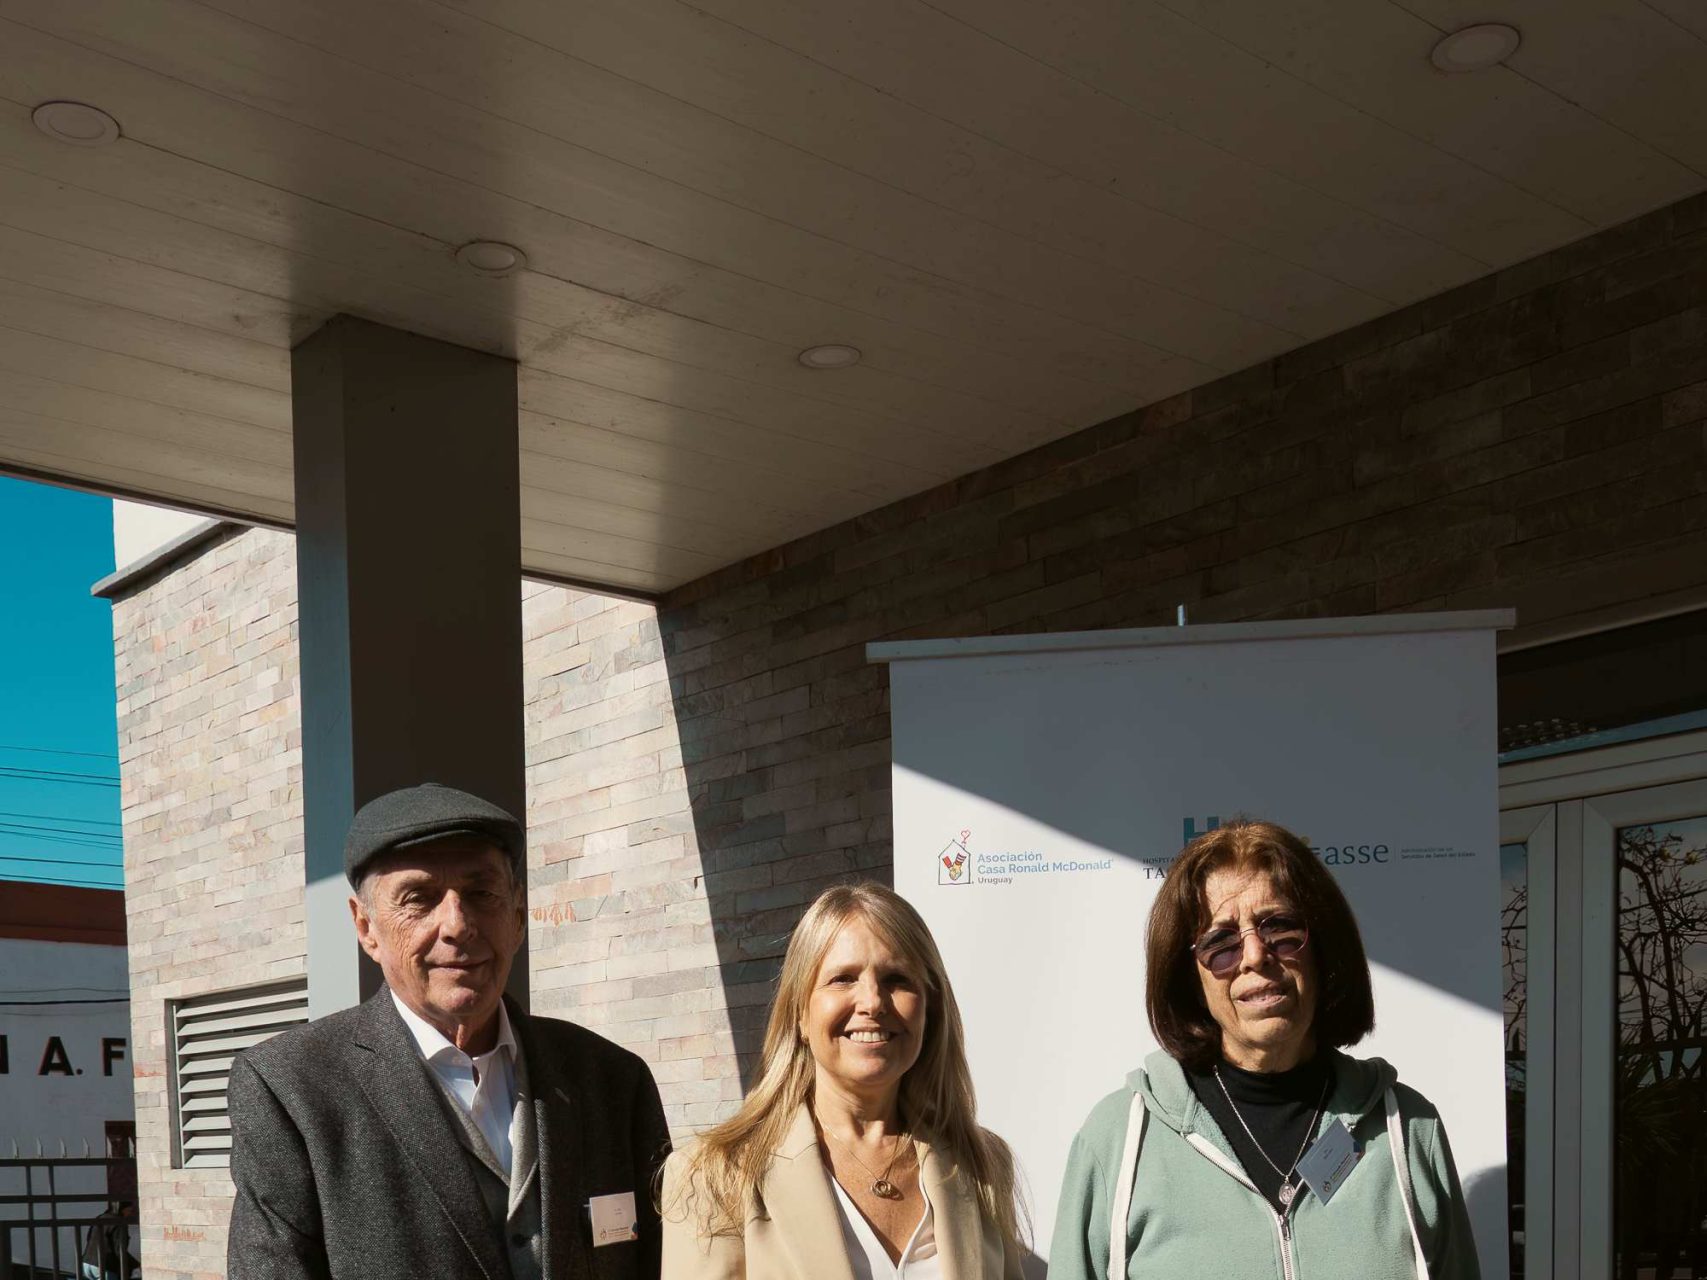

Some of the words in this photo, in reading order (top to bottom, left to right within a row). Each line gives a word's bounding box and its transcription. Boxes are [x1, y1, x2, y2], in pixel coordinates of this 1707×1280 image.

[977, 851, 1042, 864] Asociación
[1143, 856, 1175, 865] HOSPITA
[1324, 844, 1389, 865] asse
[978, 864, 1005, 875] Casa
[1008, 862, 1049, 873] Ronald
[1052, 860, 1111, 872] McDonald
[1143, 866, 1167, 879] TA
[978, 877, 1013, 885] Uruguay
